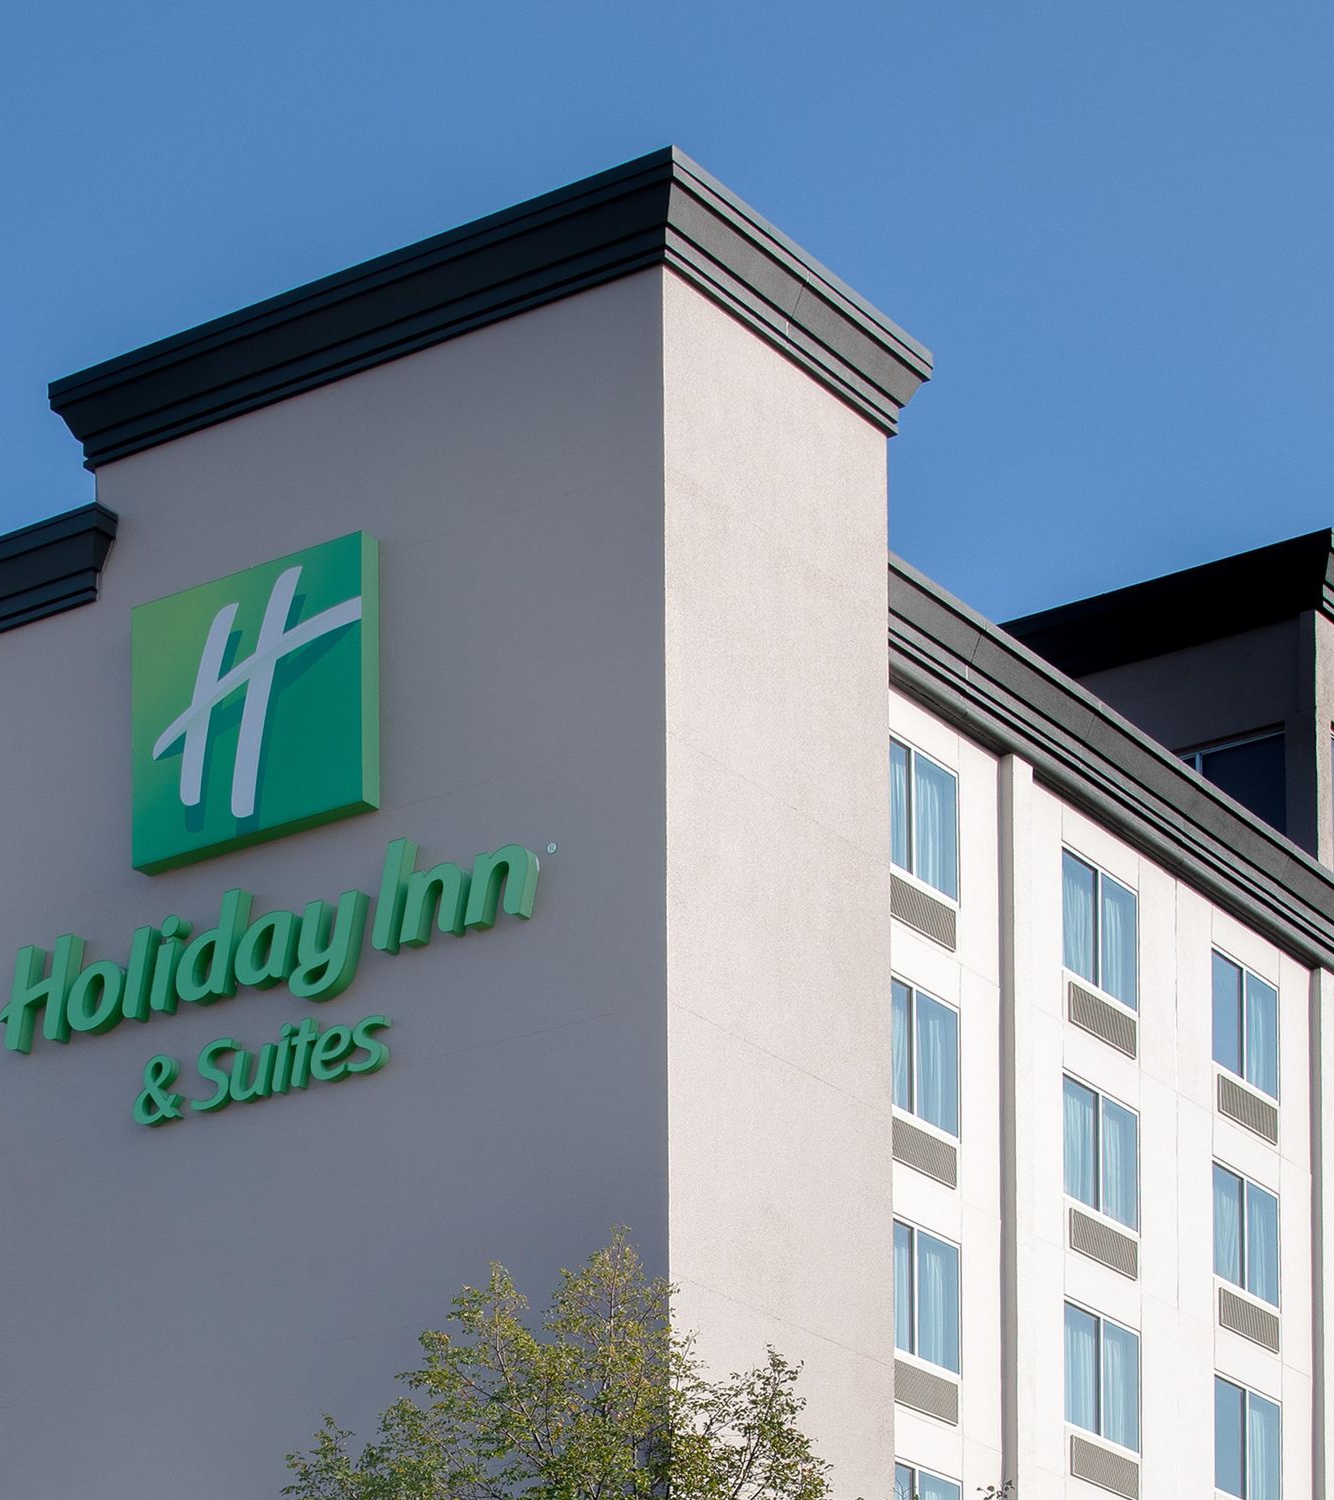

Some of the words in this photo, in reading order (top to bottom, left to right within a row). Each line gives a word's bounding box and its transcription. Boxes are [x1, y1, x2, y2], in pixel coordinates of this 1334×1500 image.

[0, 888, 370, 1054] Holiday
[372, 837, 540, 956] Inn
[133, 1054, 185, 1127] &
[189, 1014, 393, 1115] Suites
